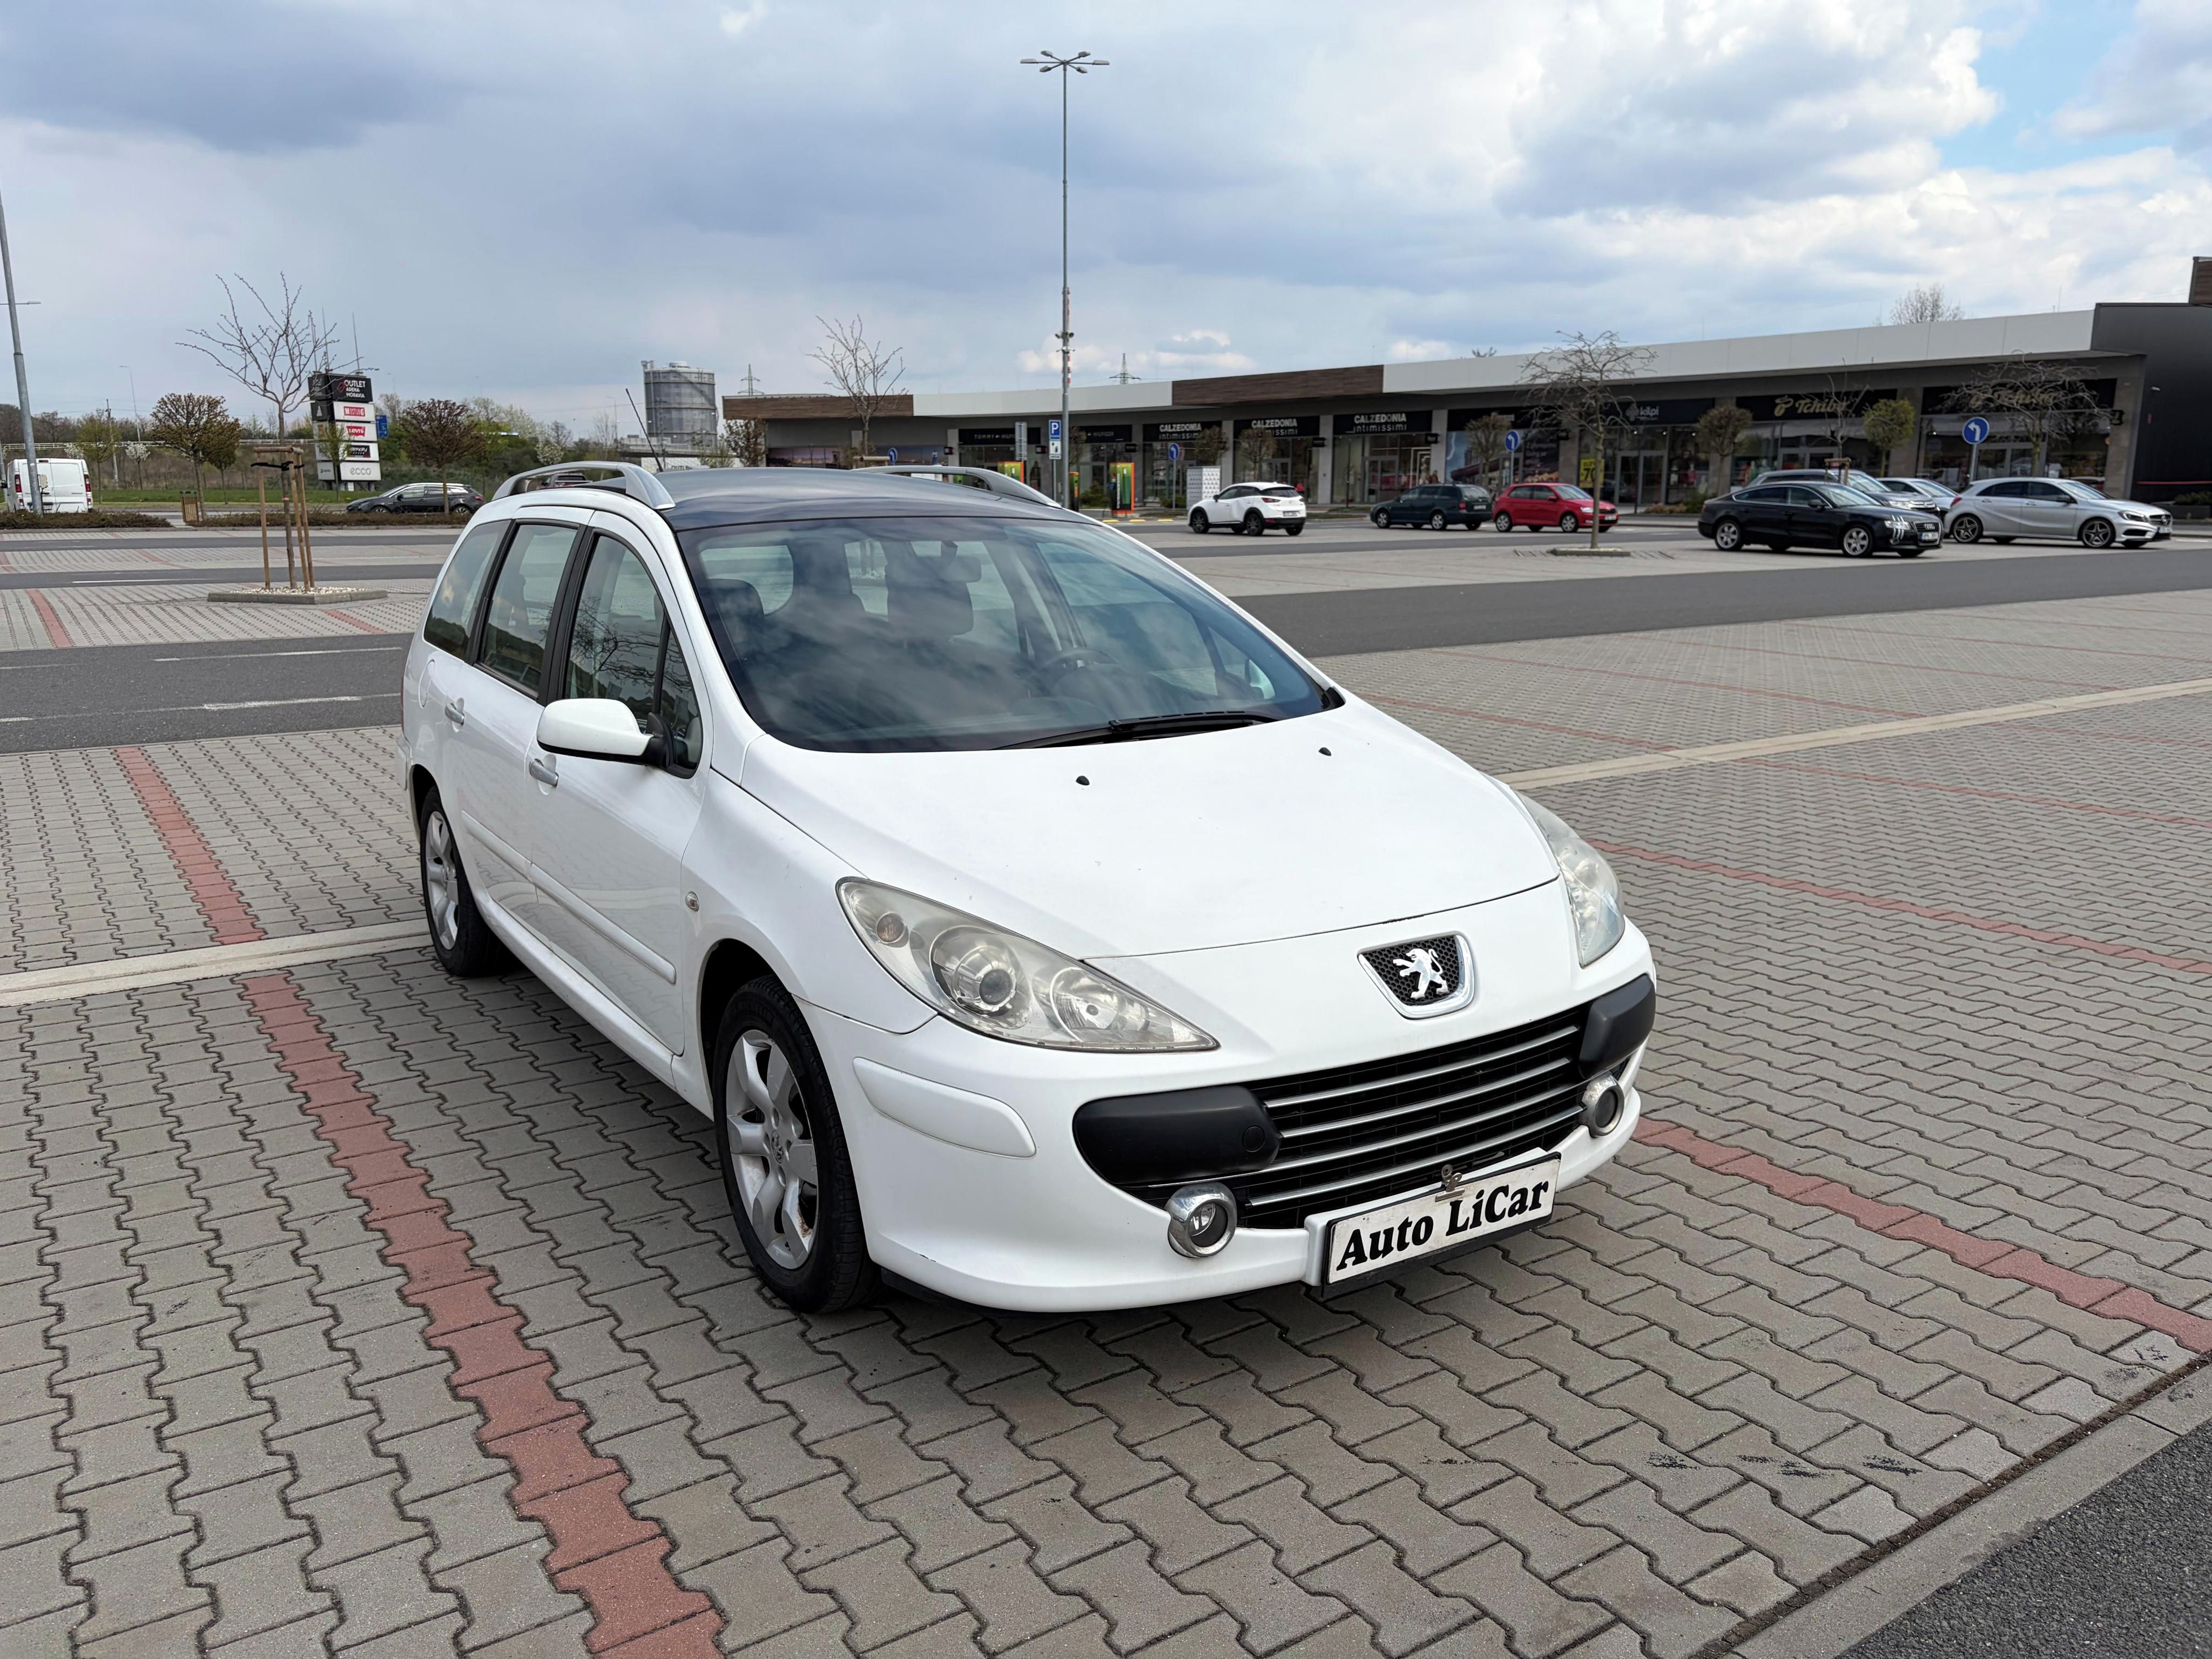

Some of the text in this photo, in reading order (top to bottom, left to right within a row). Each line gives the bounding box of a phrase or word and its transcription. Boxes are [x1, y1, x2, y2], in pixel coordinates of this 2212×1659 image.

[344, 380, 366, 388] OUTLET
[1354, 413, 1407, 423] CALZEDONIA
[1051, 422, 1059, 434] P
[1159, 423, 1202, 432] CALZEDONIA
[1251, 419, 1298, 428] CALZEDONIA
[1353, 424, 1407, 433] intimissimi
[350, 467, 372, 476] ecco
[1336, 1181, 1549, 1271] Auto LiCar
